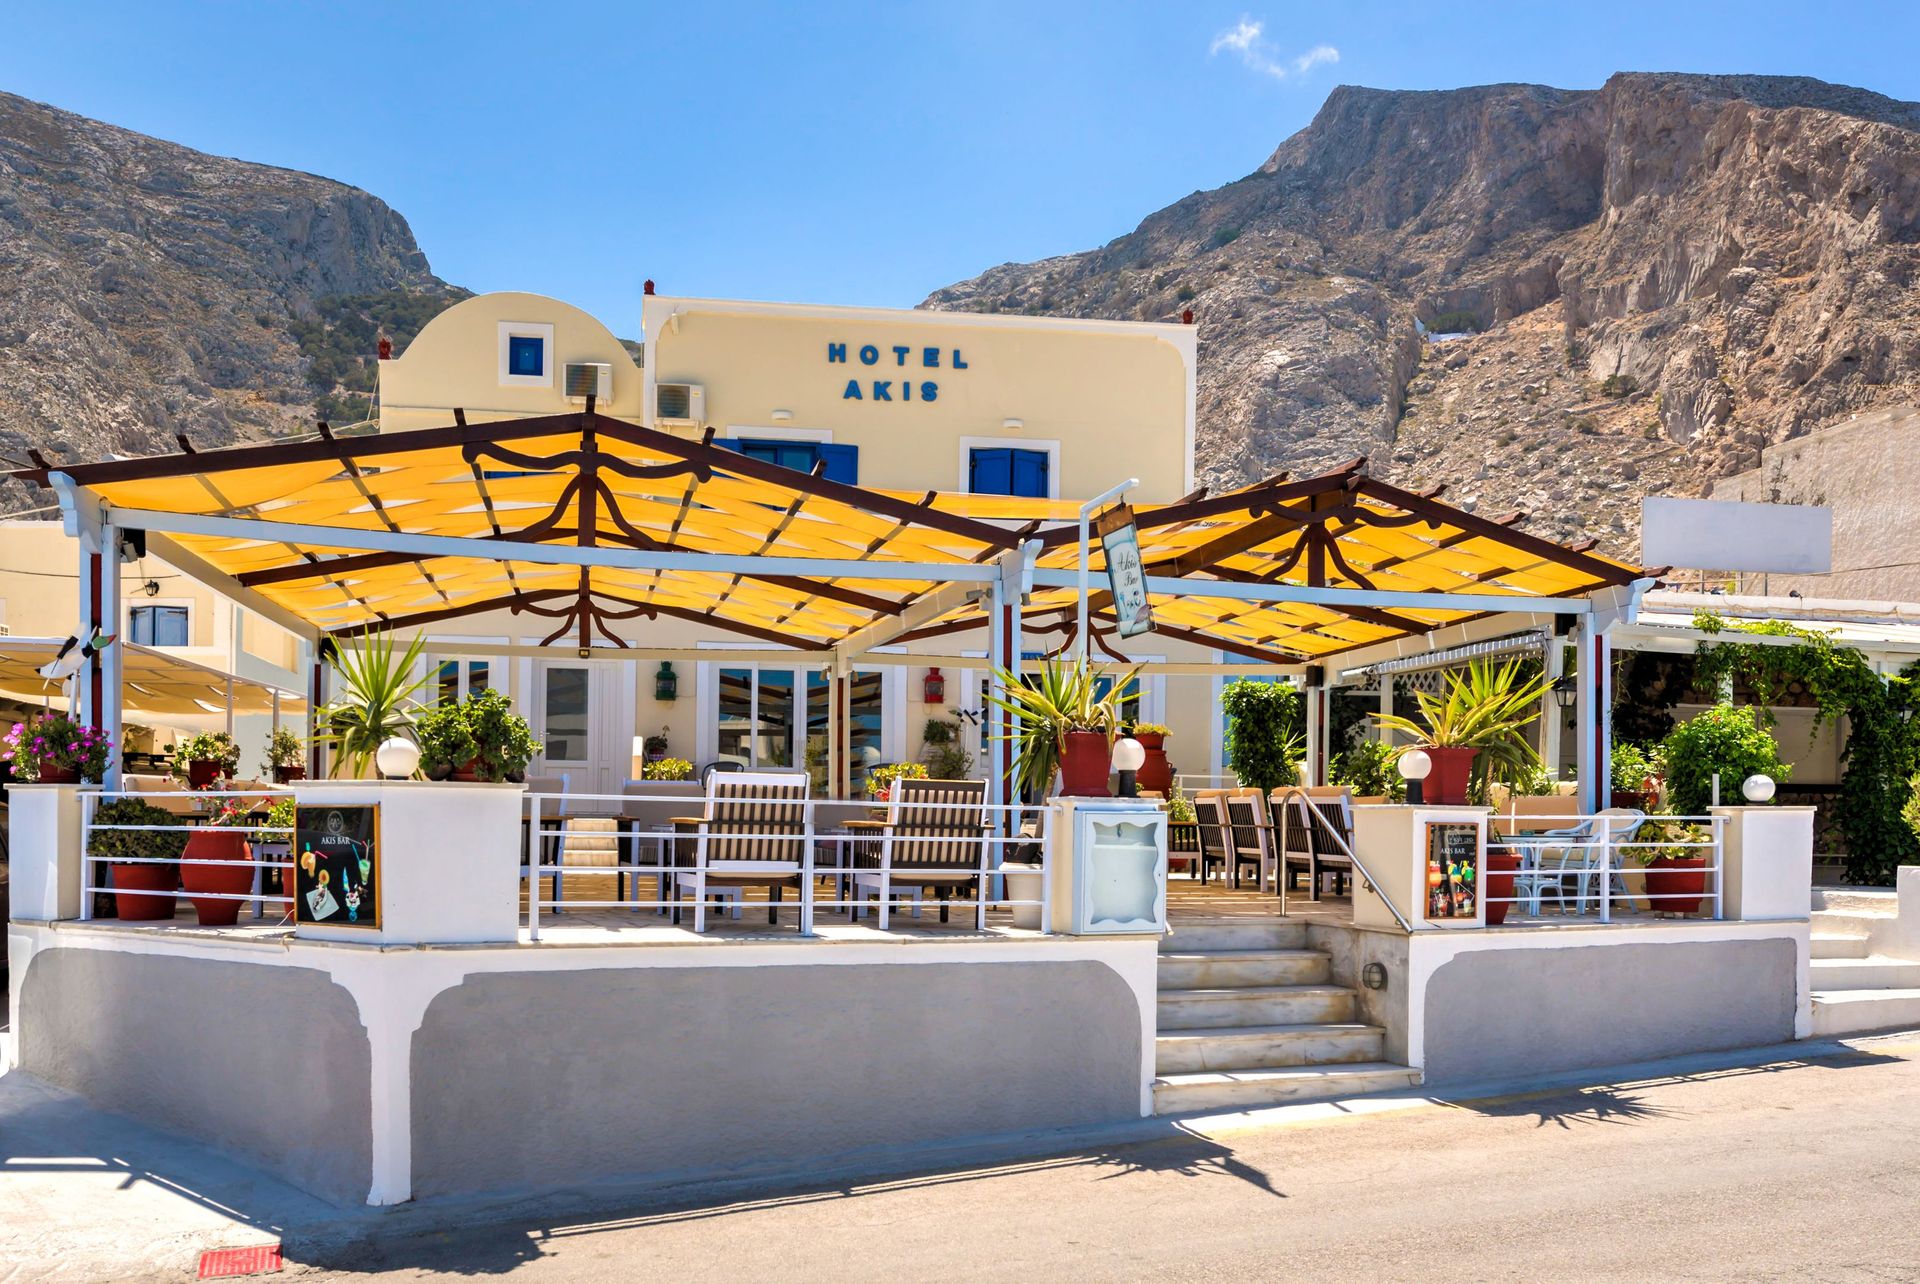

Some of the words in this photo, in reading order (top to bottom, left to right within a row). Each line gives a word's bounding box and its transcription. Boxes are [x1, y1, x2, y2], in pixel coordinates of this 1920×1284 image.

[828, 343, 968, 369] HOTEL
[843, 380, 938, 402] AKIS
[321, 836, 336, 845] AKIS
[337, 836, 351, 845] BAR
[1454, 847, 1466, 855] BAR
